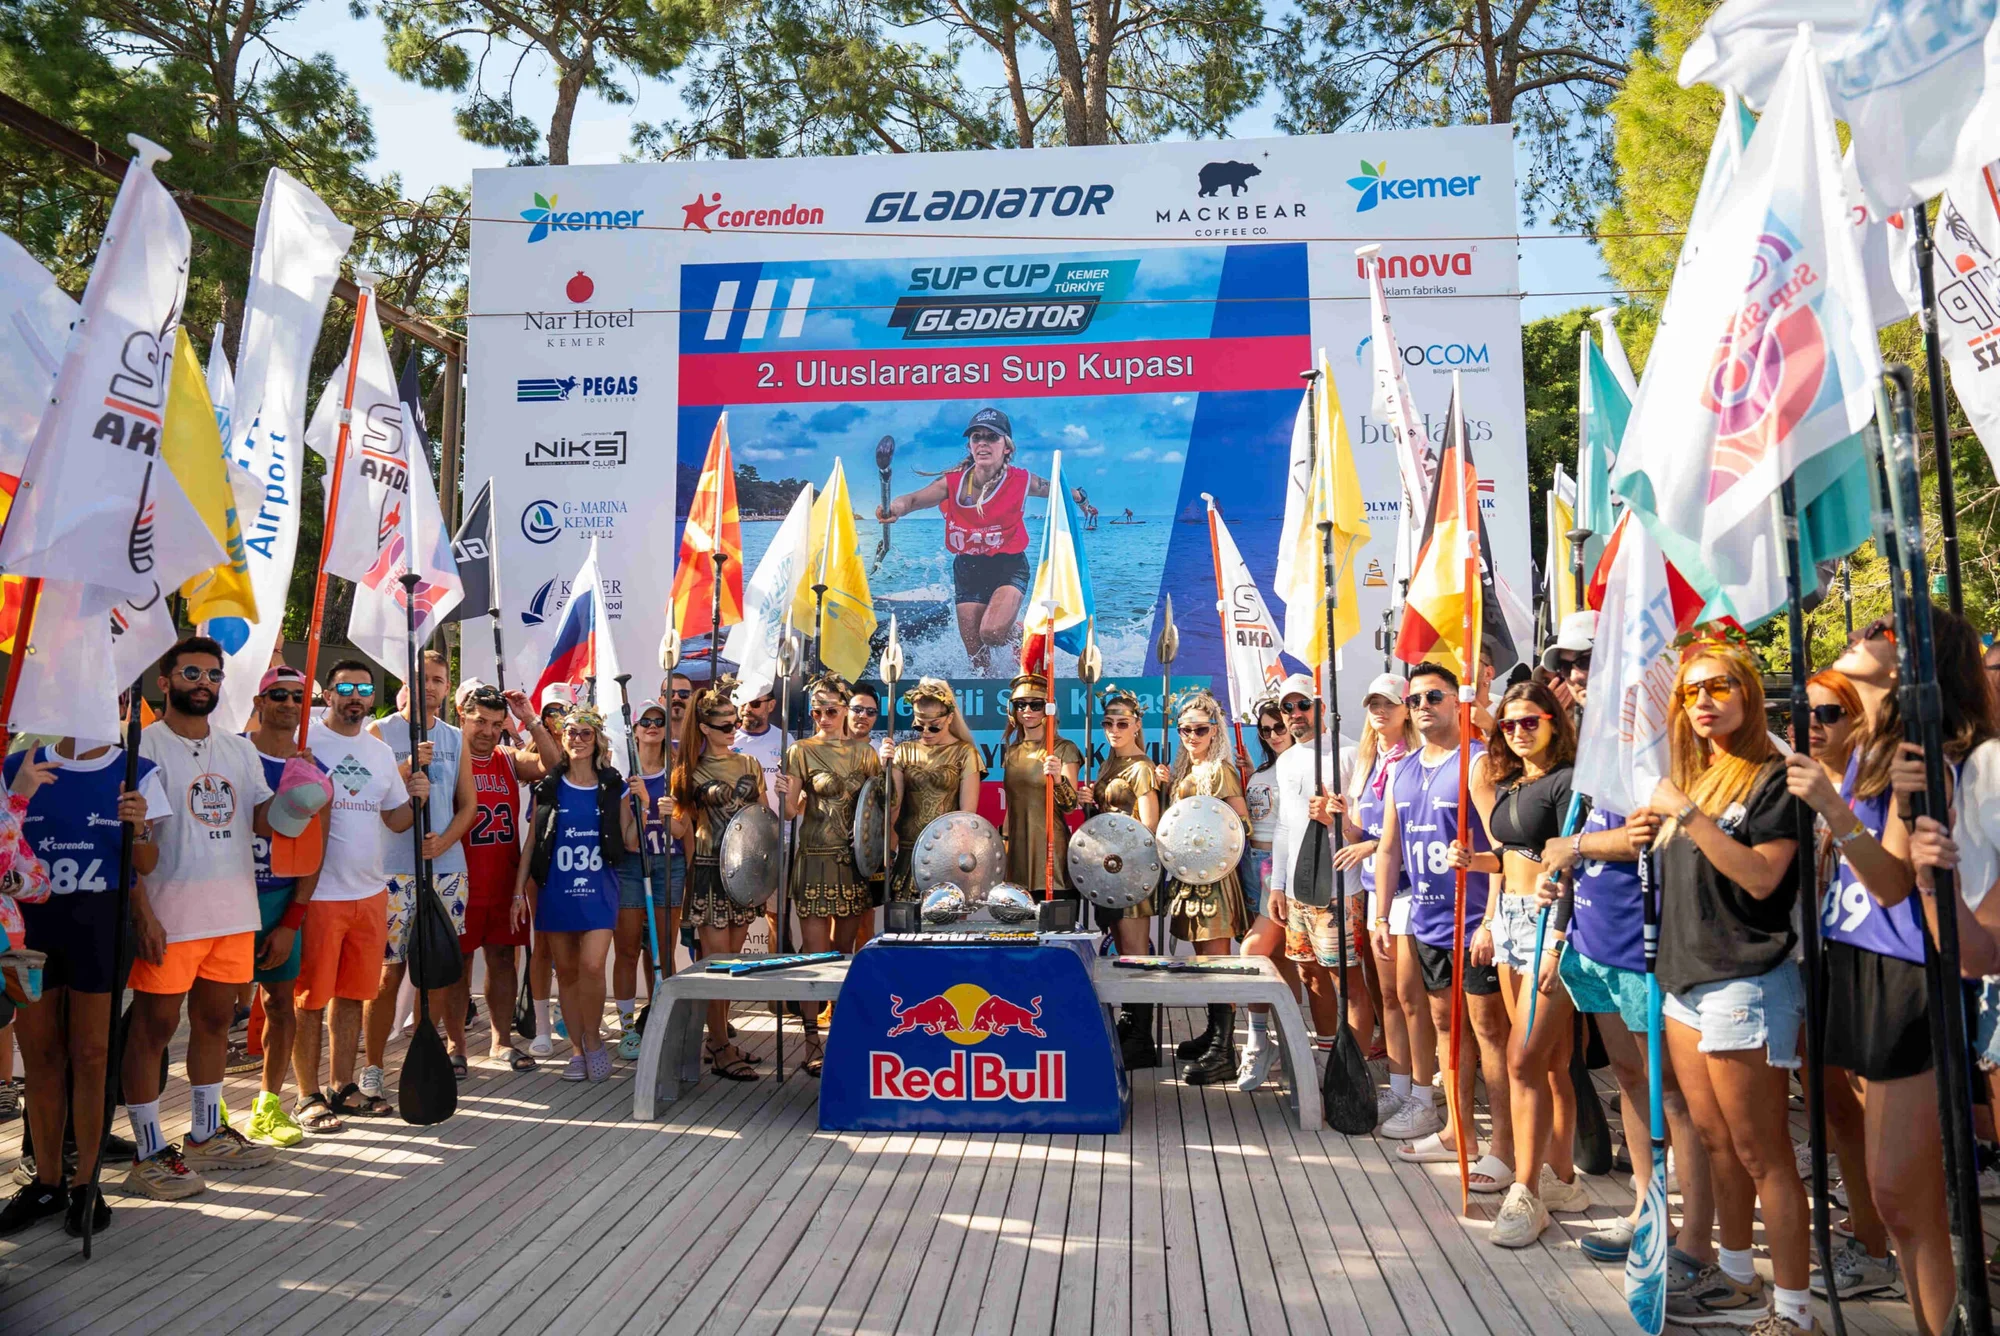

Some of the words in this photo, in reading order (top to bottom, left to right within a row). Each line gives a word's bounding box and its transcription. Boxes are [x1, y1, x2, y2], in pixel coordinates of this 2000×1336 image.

[718, 204, 824, 227] corendon
[1156, 203, 1307, 223] MACKBEAR
[1195, 228, 1247, 237] COFFEE
[1252, 227, 1268, 235] CO.
[907, 266, 977, 291] SUP
[983, 264, 1050, 288] CUP
[1067, 269, 1109, 280] KEMER
[1054, 281, 1105, 293] TÜRKİYE
[1413, 285, 1456, 296] fabrikası
[524, 310, 566, 331] Nar
[573, 308, 635, 330] Hotel
[547, 337, 606, 348] KEMER
[757, 362, 783, 389] 2.
[796, 359, 990, 388] Uluslararası
[1001, 355, 1066, 388] Sup
[1078, 352, 1194, 385] Kupası
[583, 376, 638, 396] PEGAS
[246, 430, 289, 560] Airport
[563, 502, 572, 514] G
[581, 500, 628, 514] MARINA
[564, 516, 614, 529] KEMER
[561, 580, 622, 595] KER
[473, 774, 510, 795] ULLS
[332, 798, 379, 812] olumbia
[470, 802, 514, 846] 23
[209, 830, 231, 839] CEM
[52, 841, 94, 850] corendon
[557, 845, 603, 872] 036
[869, 1050, 966, 1100] Red
[971, 1049, 1066, 1101] Bull
